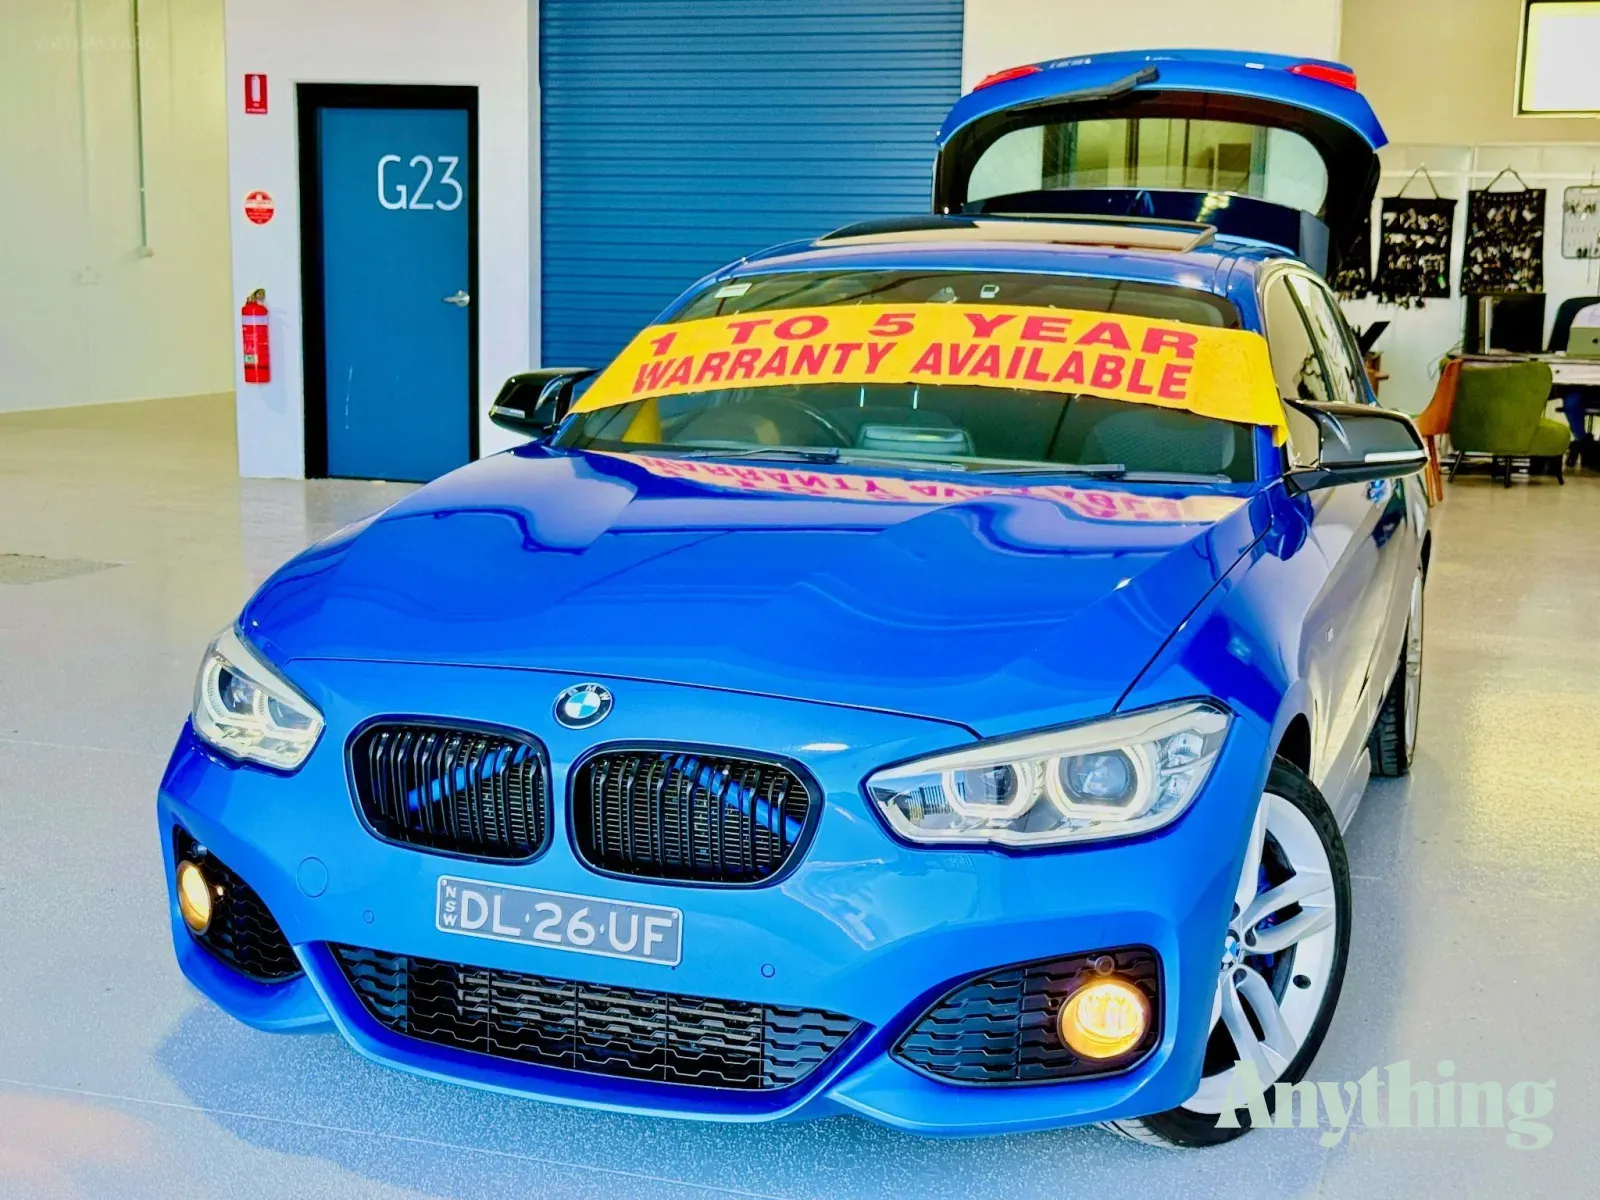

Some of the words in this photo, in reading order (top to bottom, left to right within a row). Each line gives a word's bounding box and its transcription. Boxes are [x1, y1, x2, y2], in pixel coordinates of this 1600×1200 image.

[378, 154, 463, 211] G23
[650, 332, 678, 356] 1
[726, 315, 829, 345] TO
[868, 313, 916, 337] 5
[963, 313, 1198, 359] YEAR
[632, 342, 898, 394] WARRANTY
[909, 342, 1193, 400] AVAILABLE
[442, 885, 458, 928] NSW
